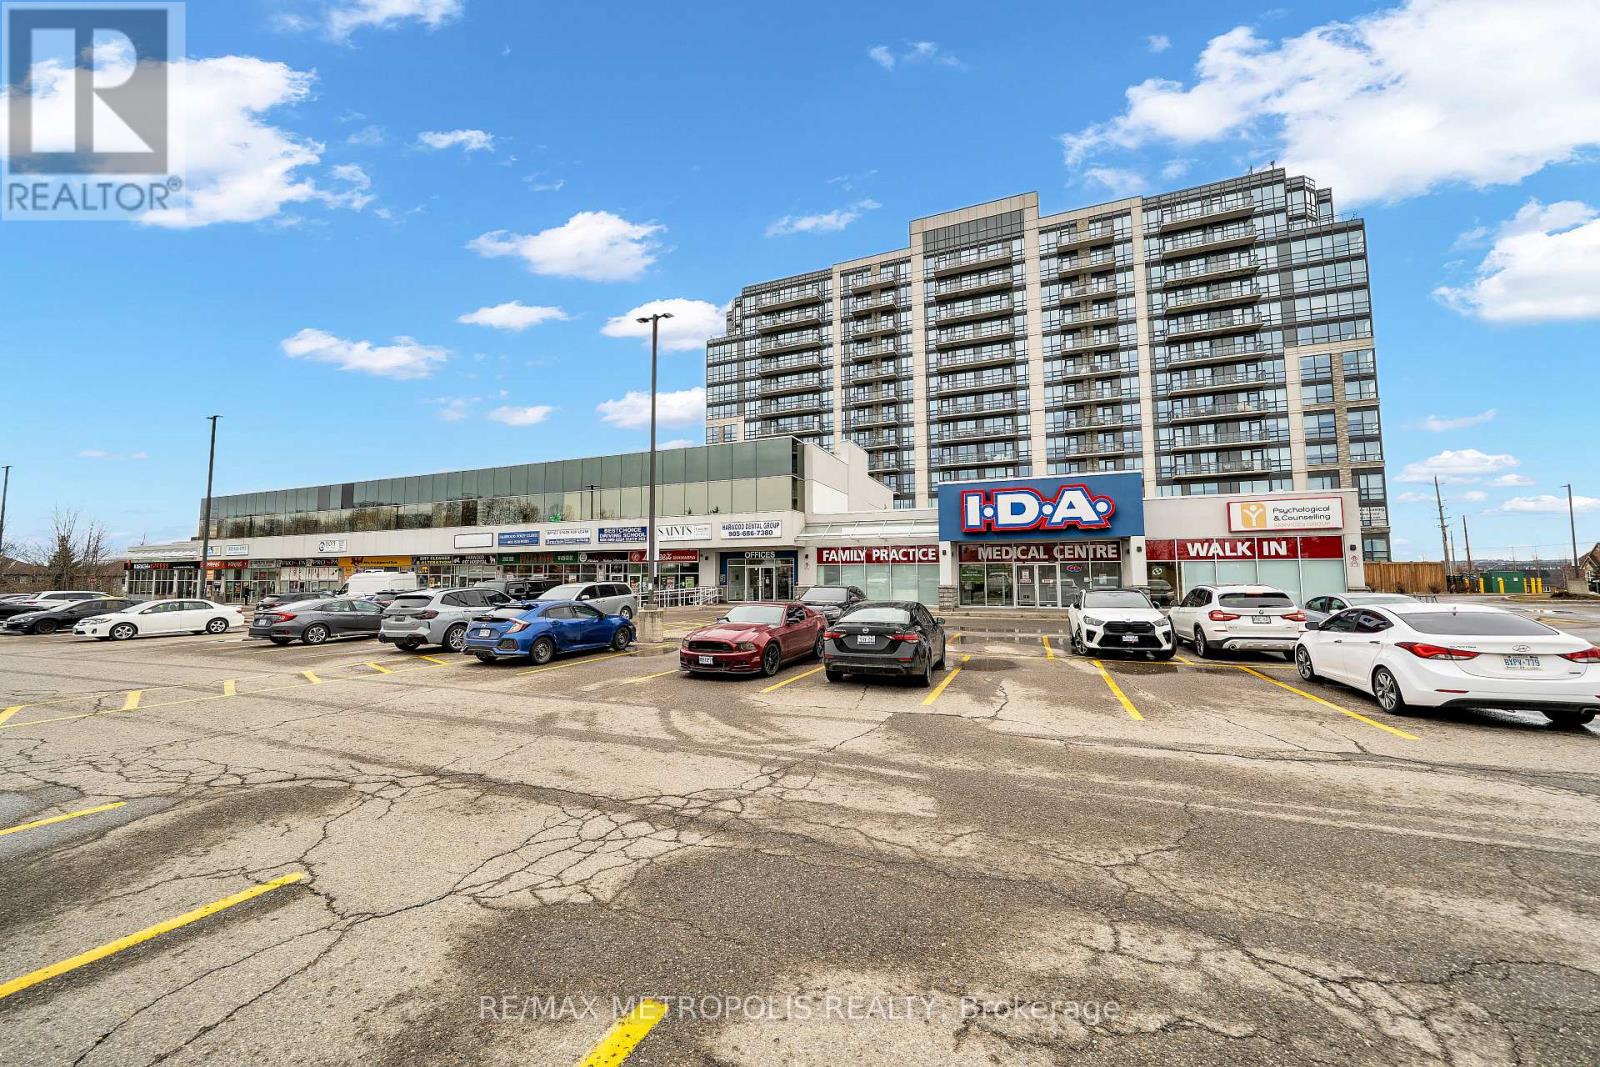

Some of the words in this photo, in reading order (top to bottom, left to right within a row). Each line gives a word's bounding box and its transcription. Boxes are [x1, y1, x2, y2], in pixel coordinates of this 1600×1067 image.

[1273, 505, 1330, 514] Psychological
[1281, 513, 1331, 521] Counselling
[746, 522, 763, 530] DENTAL
[763, 521, 780, 529] GROUP
[658, 525, 693, 537] SAINTS
[977, 545, 1048, 560] MEDICAL
[1053, 544, 1118, 559] CENTRE
[1186, 541, 1253, 557] WALK
[1262, 540, 1288, 556] IN
[744, 551, 776, 559] OFFICES
[822, 548, 866, 562] FAMILY
[872, 547, 937, 561] PRACTICE
